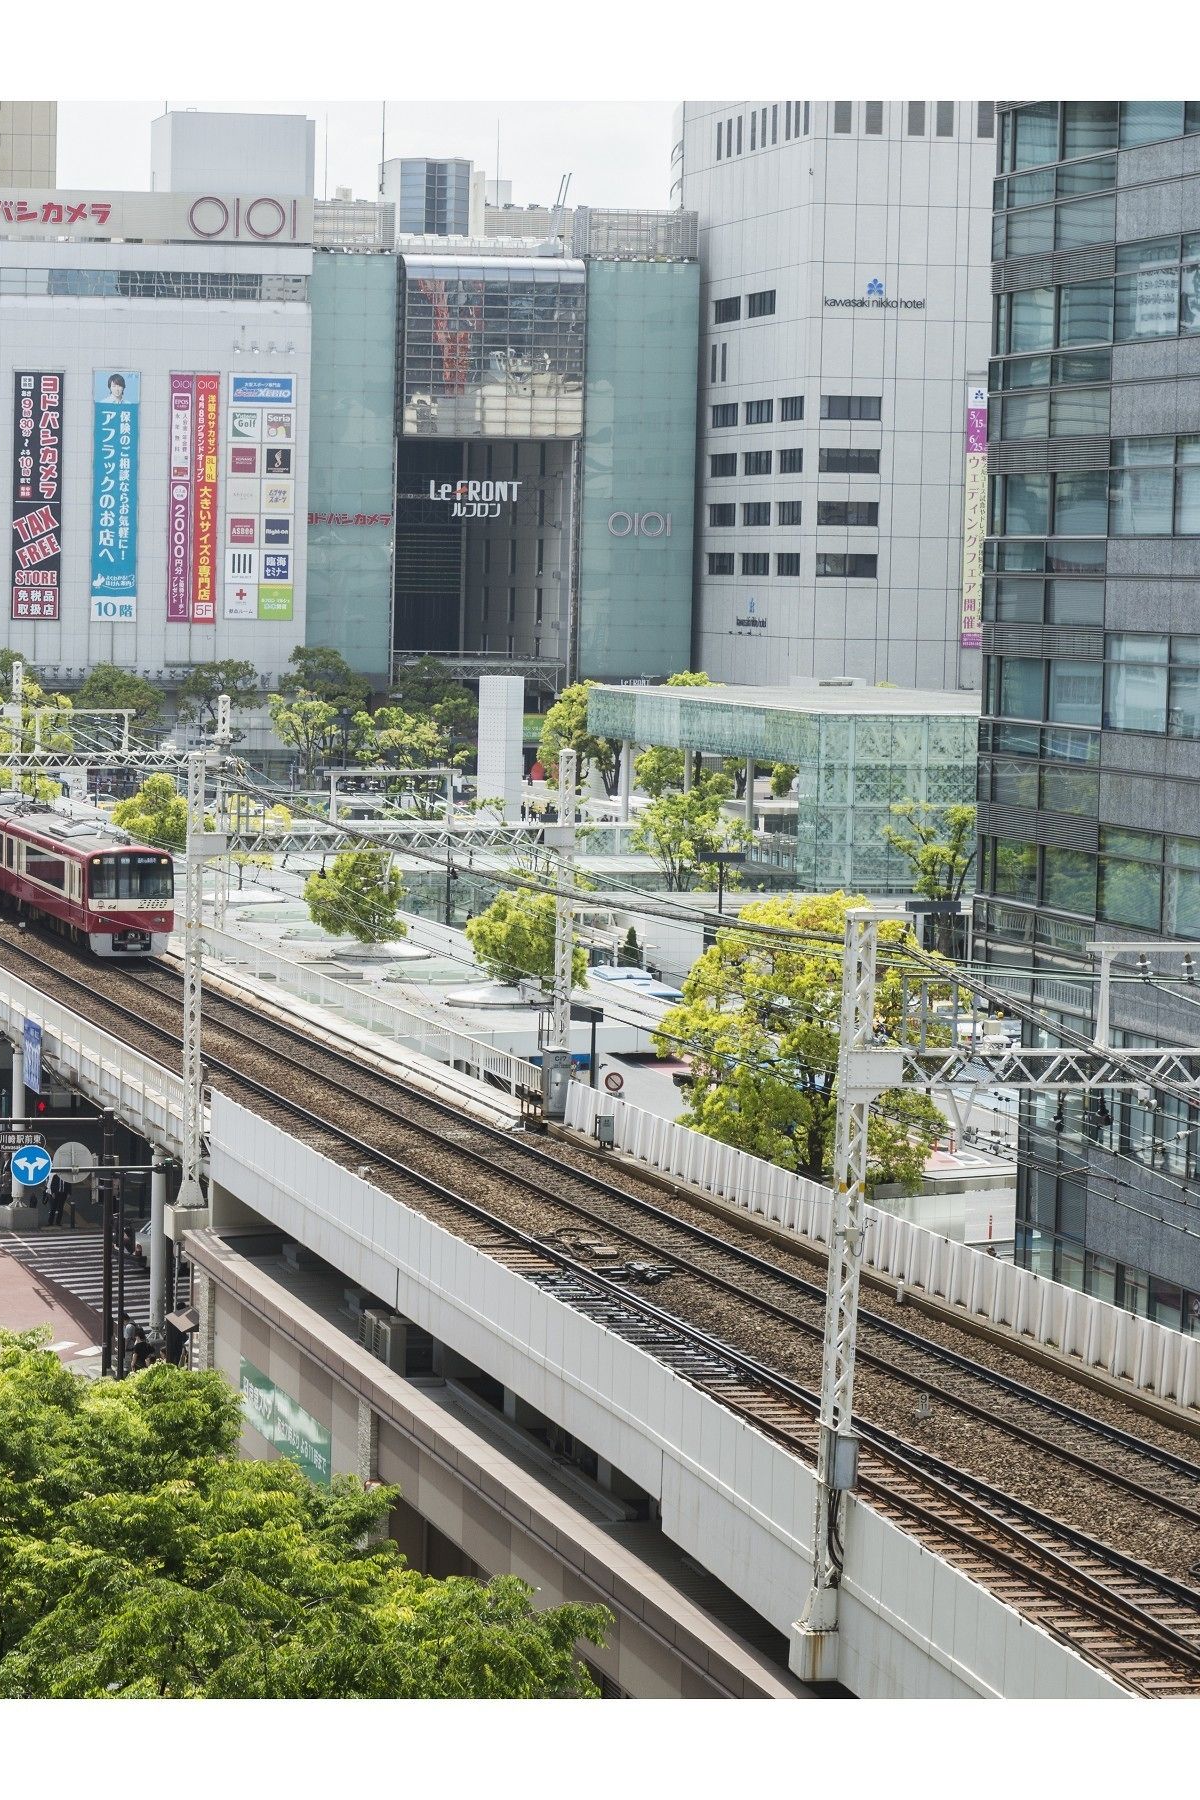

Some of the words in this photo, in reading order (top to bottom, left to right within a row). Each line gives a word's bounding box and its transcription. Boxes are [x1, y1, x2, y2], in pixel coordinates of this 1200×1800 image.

[823, 296, 870, 308] kawasaki
[872, 297, 899, 309] nikko
[900, 297, 926, 309] hotel
[207, 395, 216, 454] 洋服のサカゼン
[238, 419, 257, 428] Golf
[267, 414, 291, 422] Seria
[39, 376, 60, 499] ヨドバシカメラ
[98, 411, 117, 563] アフラックのお店へ
[429, 479, 452, 501] Le
[455, 480, 523, 502] FRONT
[450, 502, 501, 518] ルフロン
[12, 505, 60, 543] TAX
[307, 512, 392, 528] ヨドバシカメラ
[197, 486, 213, 601] 大きいサイズの専門店
[963, 456, 980, 629] ウェディングフェア開催
[15, 532, 61, 570] FREE
[266, 556, 287, 567] 臨海
[15, 569, 57, 586] STORE
[265, 568, 288, 577] セミナー
[17, 589, 55, 602] 免税品
[17, 603, 55, 616] 取扱店
[94, 601, 133, 618] 10階
[195, 604, 212, 616] 5F
[137, 899, 168, 909] 2100
[0, 1134, 42, 1144] 川崎駅前東
